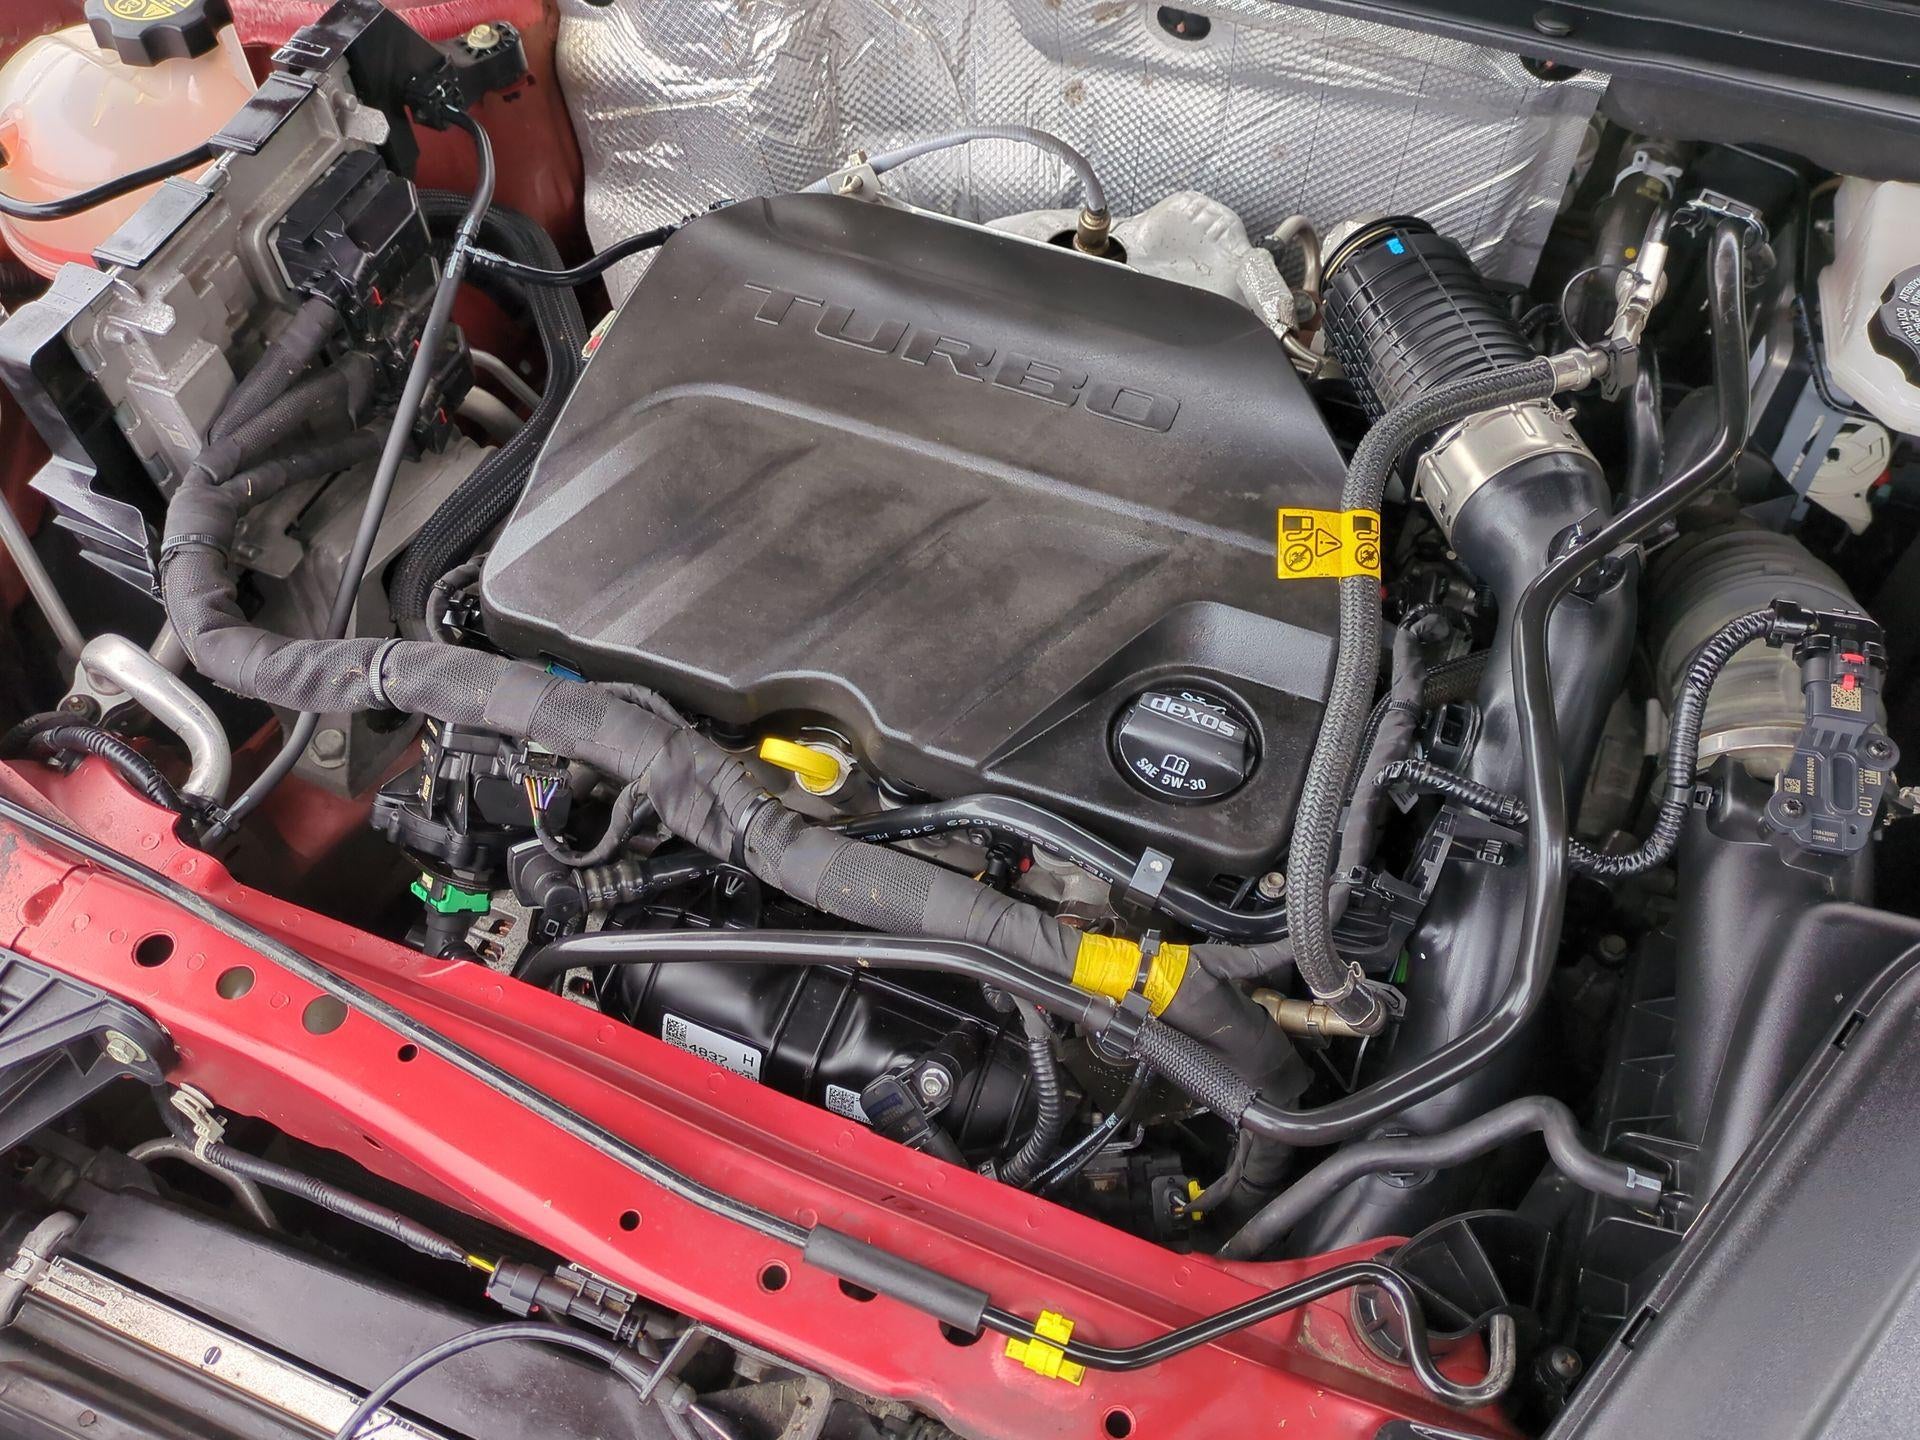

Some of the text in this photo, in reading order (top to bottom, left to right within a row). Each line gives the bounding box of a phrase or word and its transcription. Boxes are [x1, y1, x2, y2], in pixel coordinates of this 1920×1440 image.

[744, 282, 1182, 434] TURBO
[1149, 696, 1235, 737] dexos
[1136, 757, 1207, 791] SAE 5W-30
[1864, 769, 1880, 785] GM
[743, 1053, 754, 1067] H
